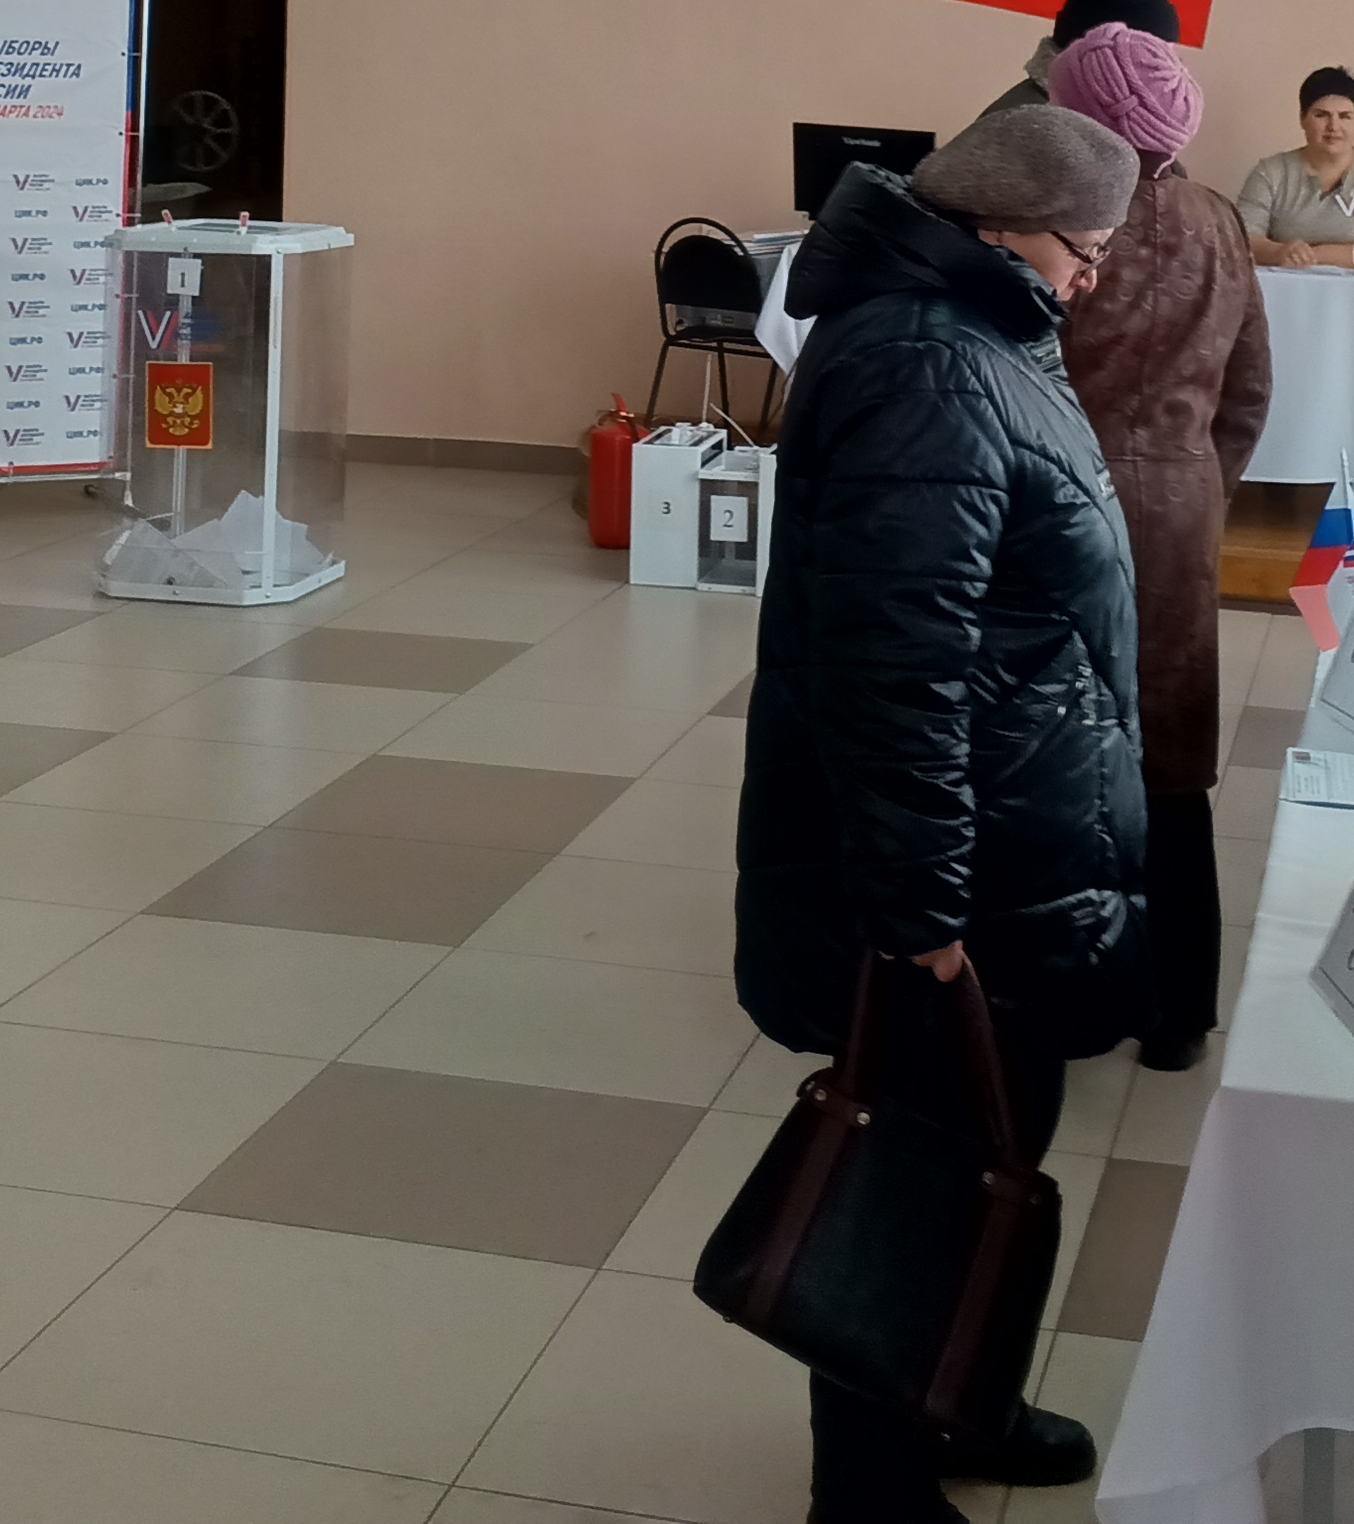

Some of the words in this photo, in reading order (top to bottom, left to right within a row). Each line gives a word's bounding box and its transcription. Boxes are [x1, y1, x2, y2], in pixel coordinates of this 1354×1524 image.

[32, 106, 65, 119] 2024
[179, 271, 187, 288] 1
[661, 501, 672, 515] 3
[723, 510, 734, 528] 2
